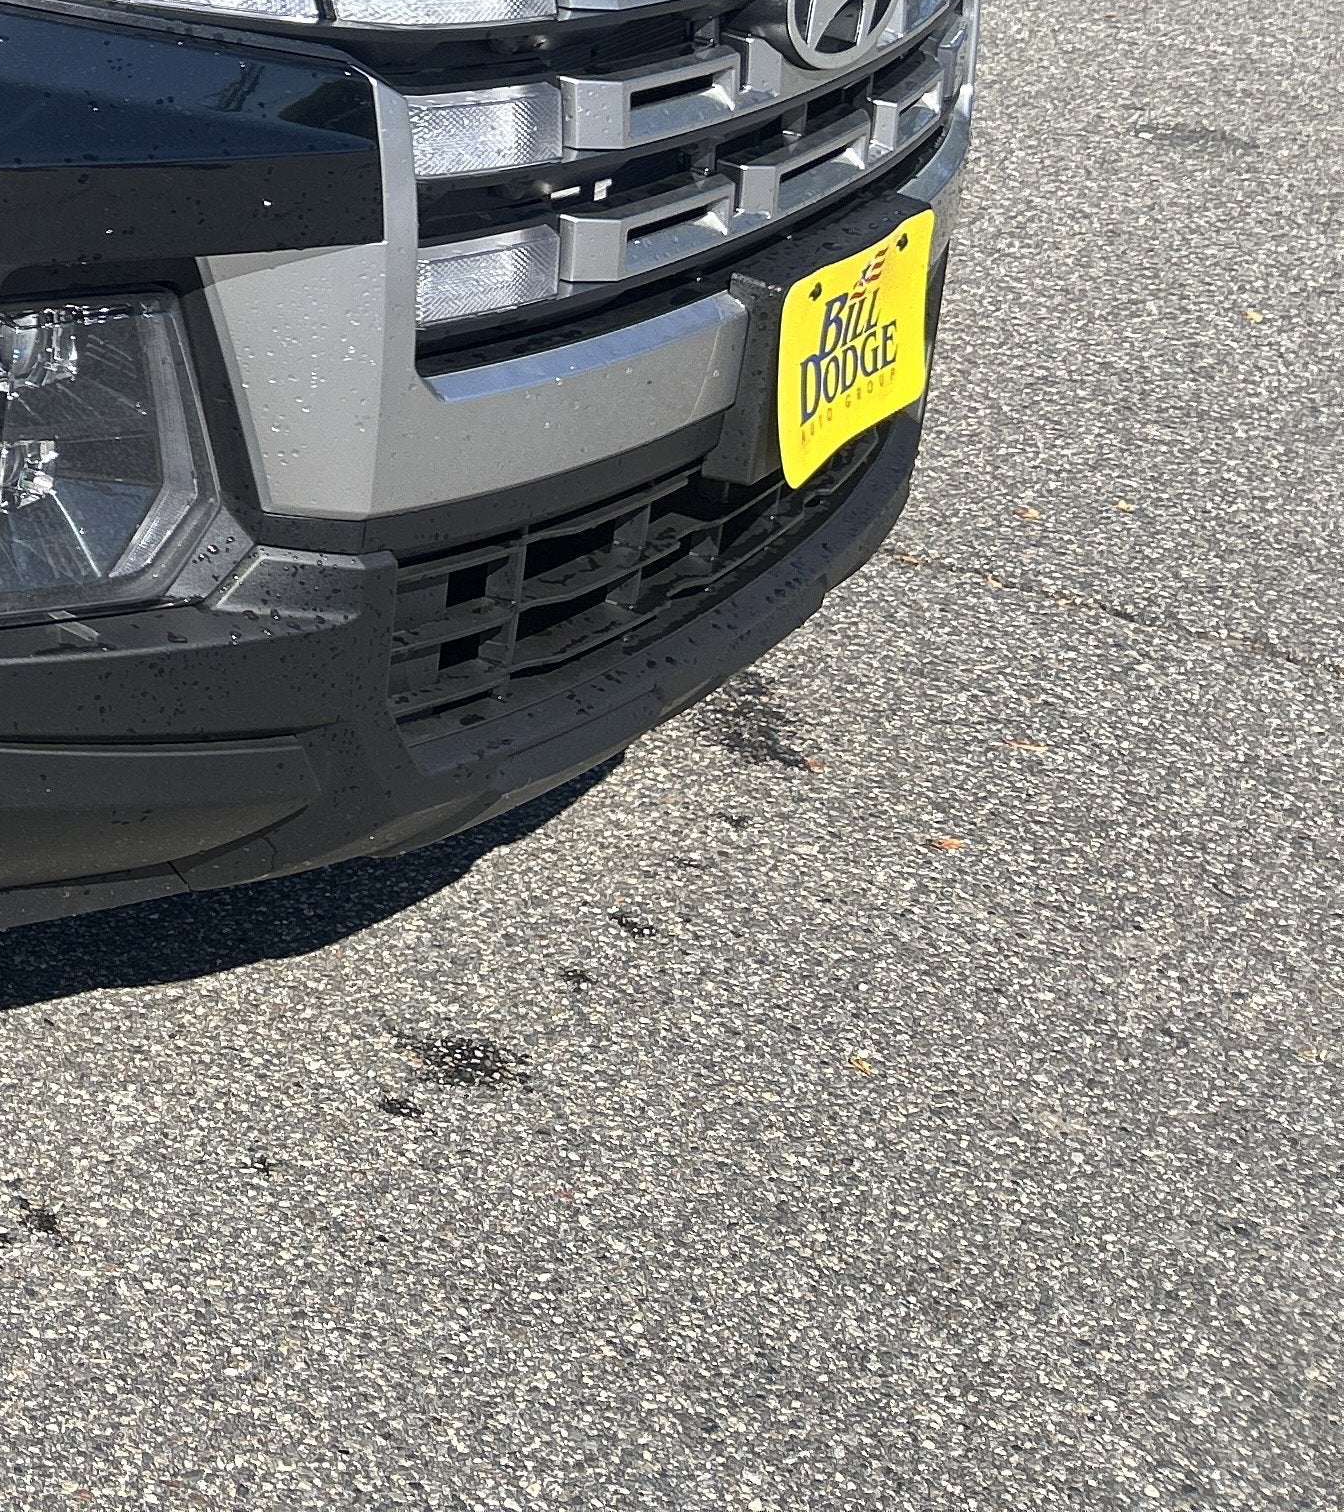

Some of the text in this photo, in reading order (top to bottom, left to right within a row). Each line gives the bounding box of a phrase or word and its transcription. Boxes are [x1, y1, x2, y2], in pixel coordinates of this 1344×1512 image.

[818, 287, 882, 360] BILL
[799, 319, 899, 428] DODGE
[800, 367, 895, 448] AUTO GROUP
